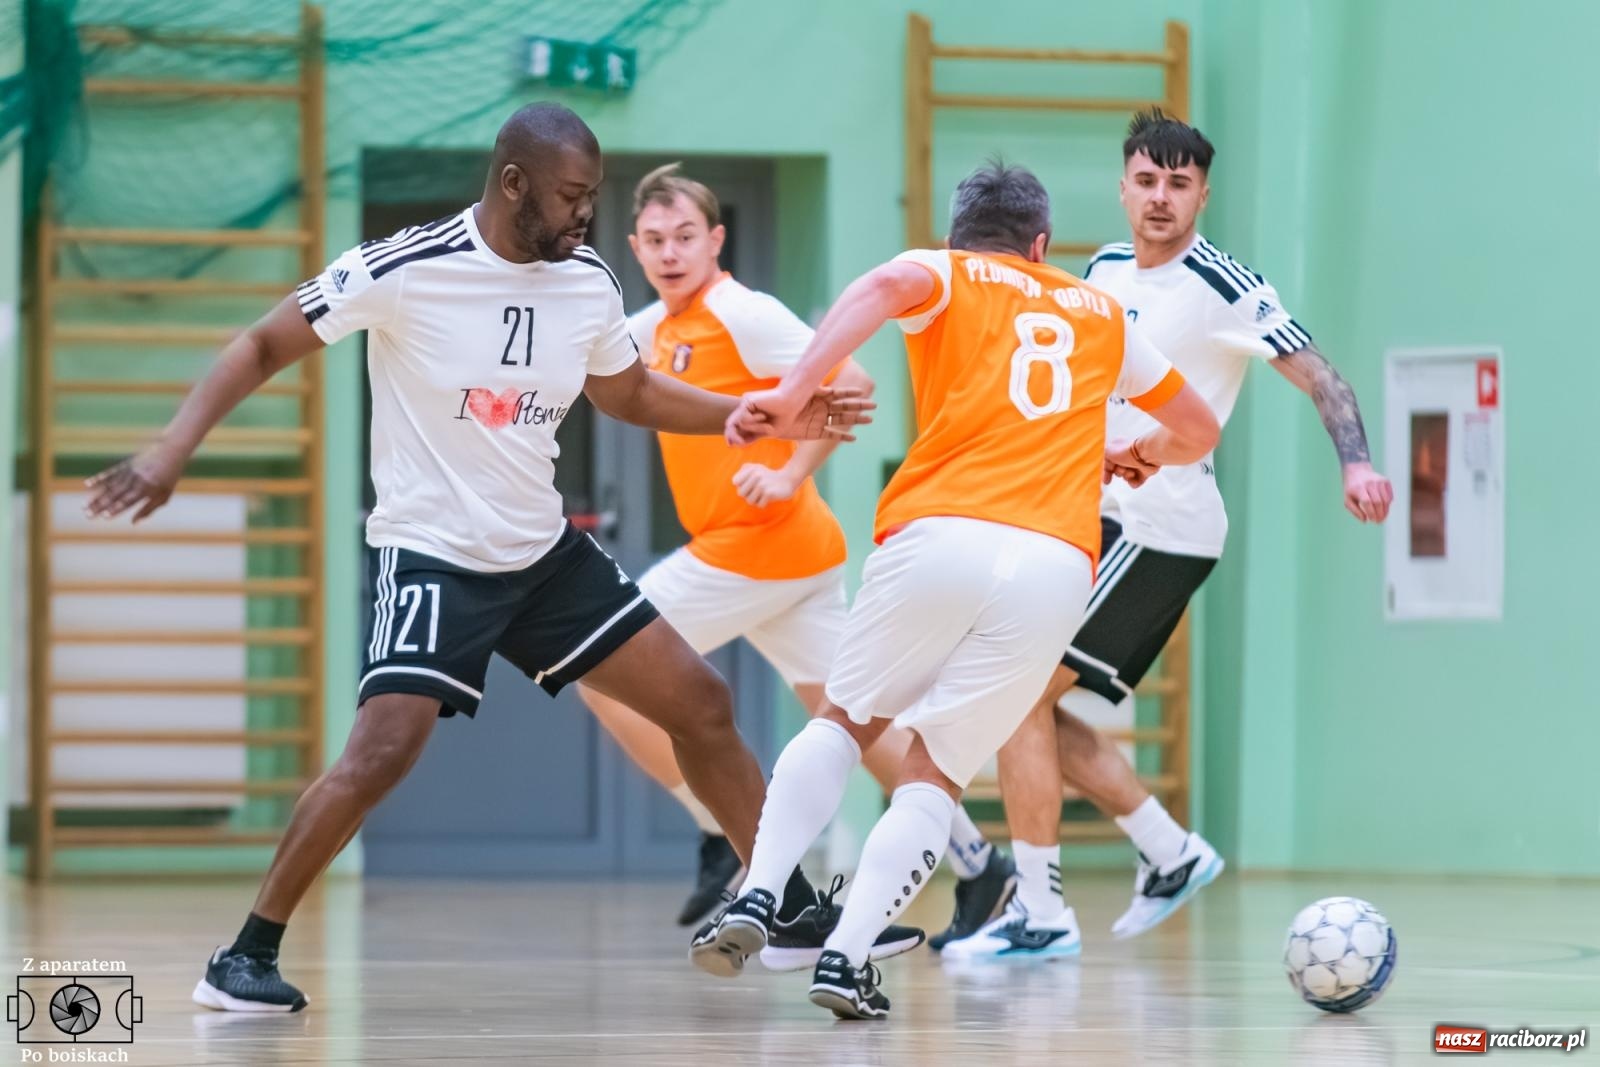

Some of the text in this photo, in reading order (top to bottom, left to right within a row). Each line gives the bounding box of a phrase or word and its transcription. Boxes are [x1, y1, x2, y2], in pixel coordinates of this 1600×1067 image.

[500, 306, 534, 367] 21
[1008, 311, 1075, 421] 8
[394, 583, 441, 653] 21
